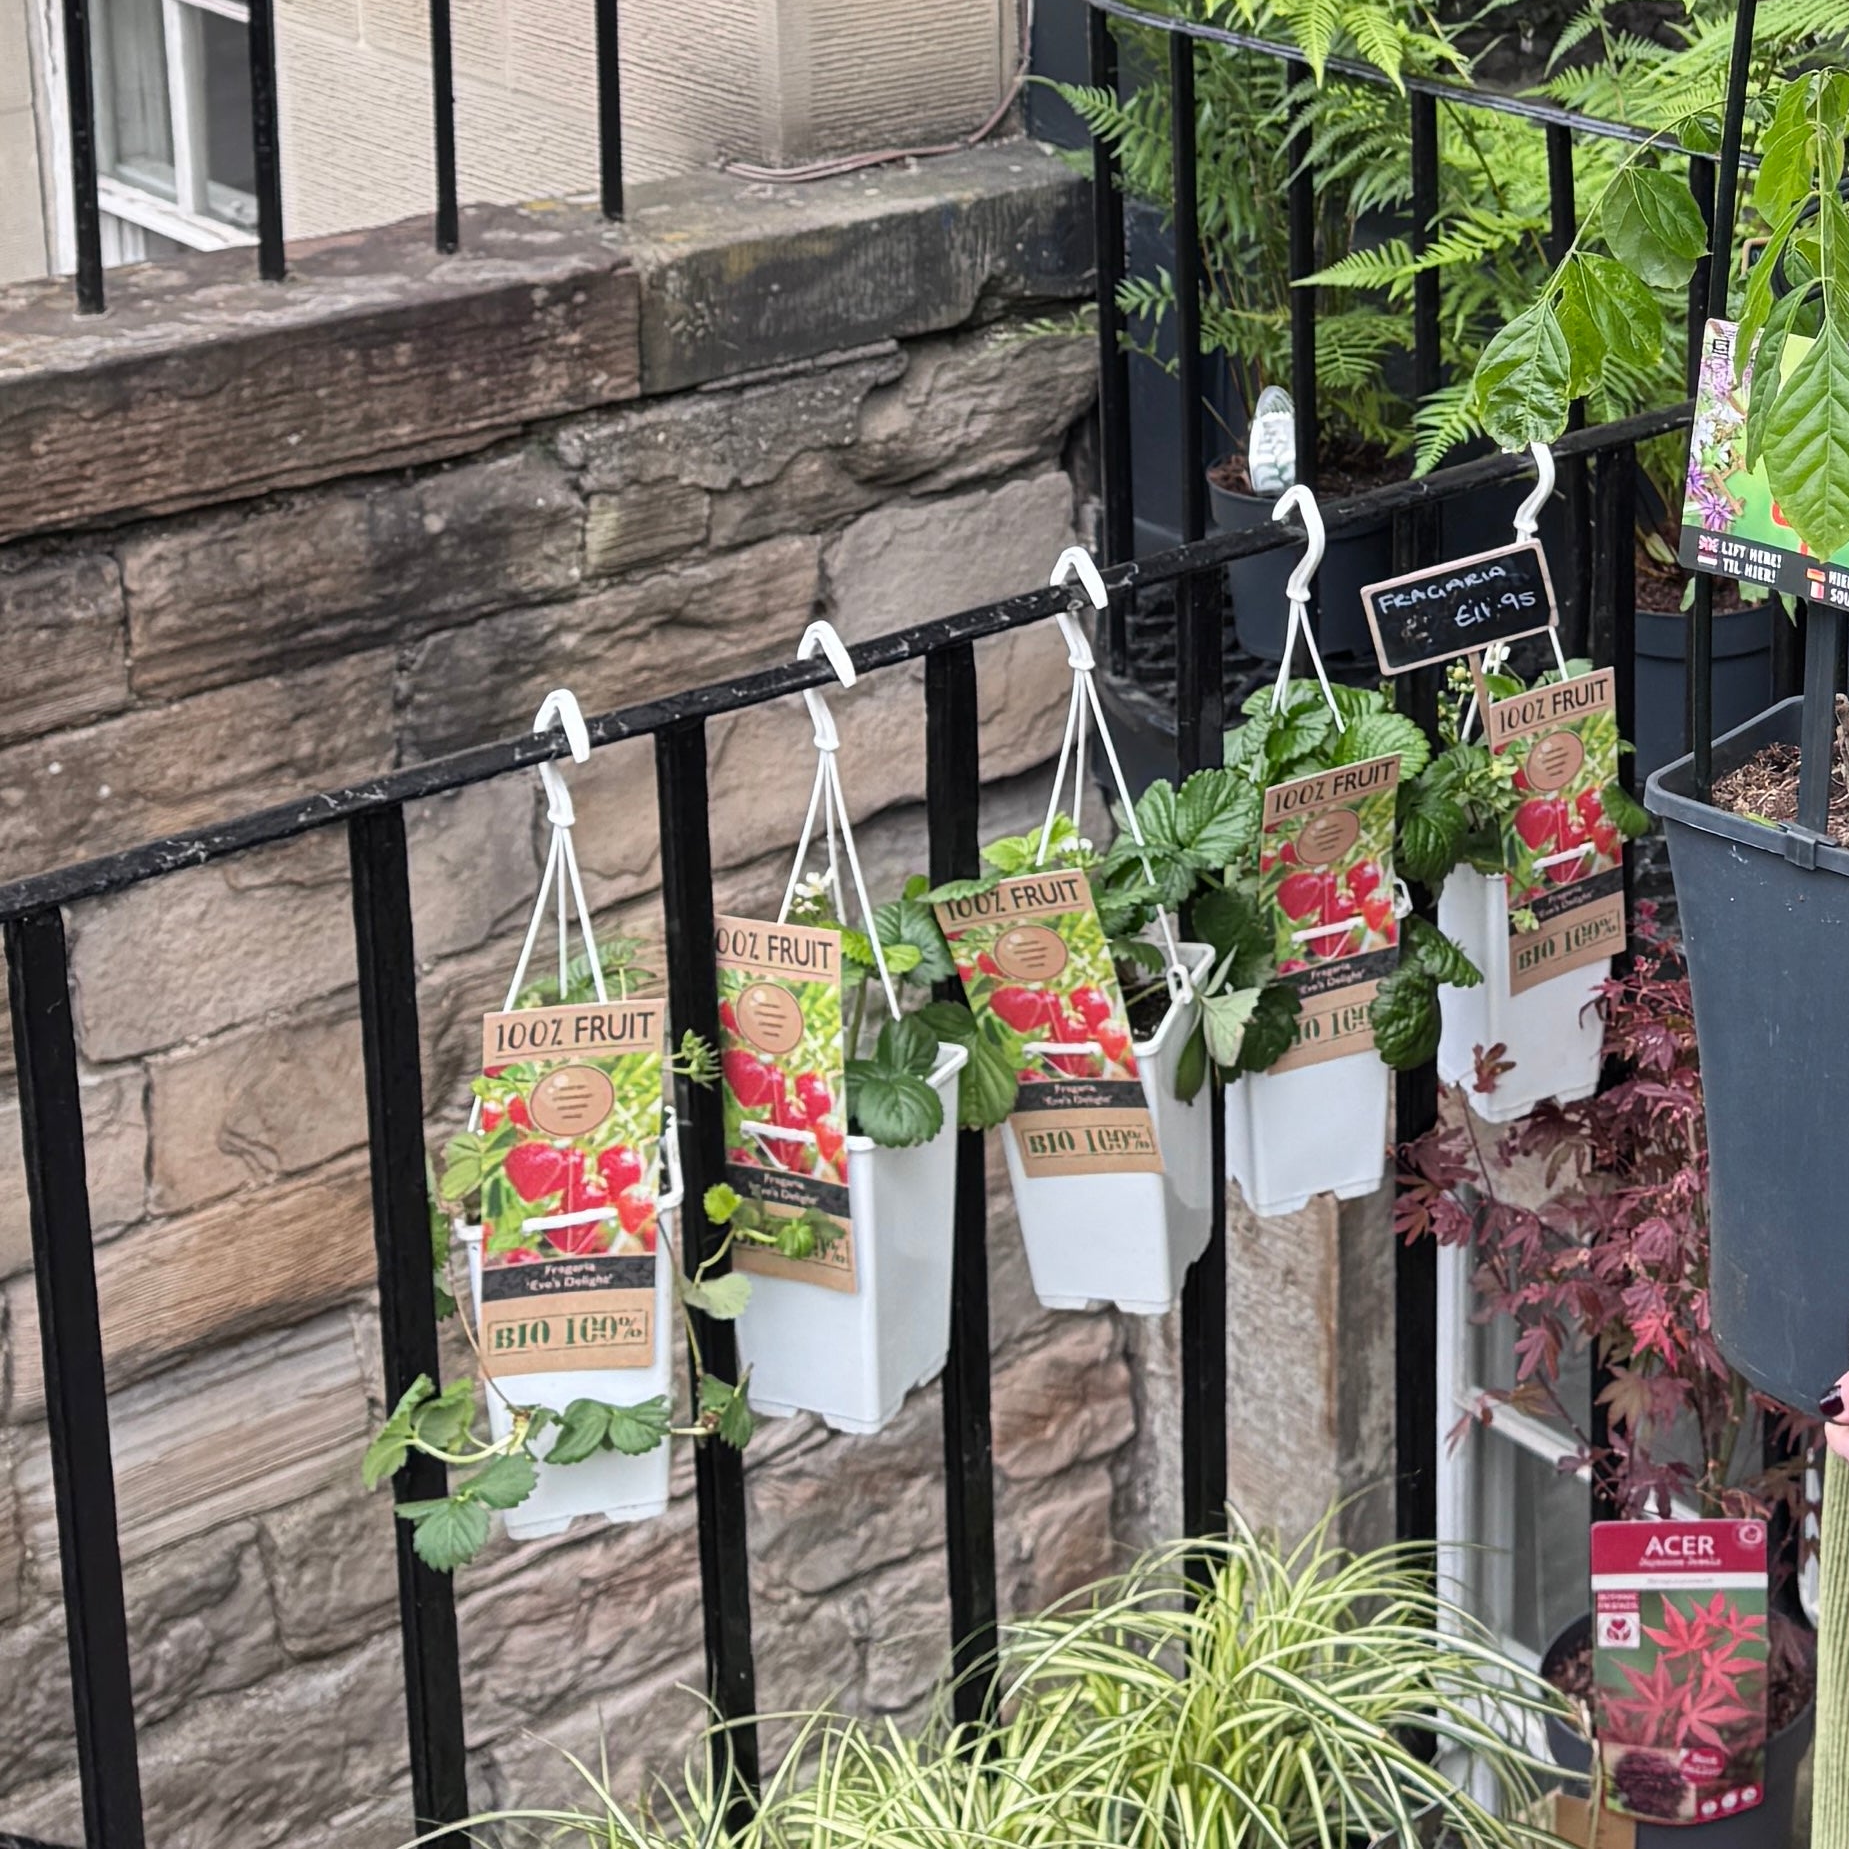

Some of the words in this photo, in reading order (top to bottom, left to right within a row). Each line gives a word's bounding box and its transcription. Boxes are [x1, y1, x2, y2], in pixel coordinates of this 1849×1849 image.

[1722, 541, 1747, 558] LIFT
[1750, 548, 1782, 569] HERE!
[1723, 558, 1742, 575] TIL
[1744, 564, 1776, 584] HIER!
[1378, 565, 1507, 615] FRAGARIA
[1454, 591, 1537, 628] £11.95
[1500, 698, 1545, 733] 100%
[1552, 679, 1609, 714] FRUIT
[1275, 780, 1325, 813] 100%
[1333, 761, 1395, 796] FRUIT
[1010, 879, 1078, 908] FRUIT
[716, 928, 759, 960] 00%
[768, 935, 833, 969] FRUIT
[1518, 937, 1555, 969] BIO
[1564, 917, 1617, 953] 100%
[497, 1018, 563, 1052] 100%
[574, 1012, 655, 1043] FRUIT
[1028, 1130, 1075, 1154] BIO
[1085, 1128, 1150, 1153] 100%
[544, 1263, 596, 1276] Fragaria
[564, 1273, 613, 1288] Delight'
[495, 1319, 550, 1349] BIO
[565, 1315, 642, 1345] 100%
[1645, 1535, 1715, 1557] ACER
